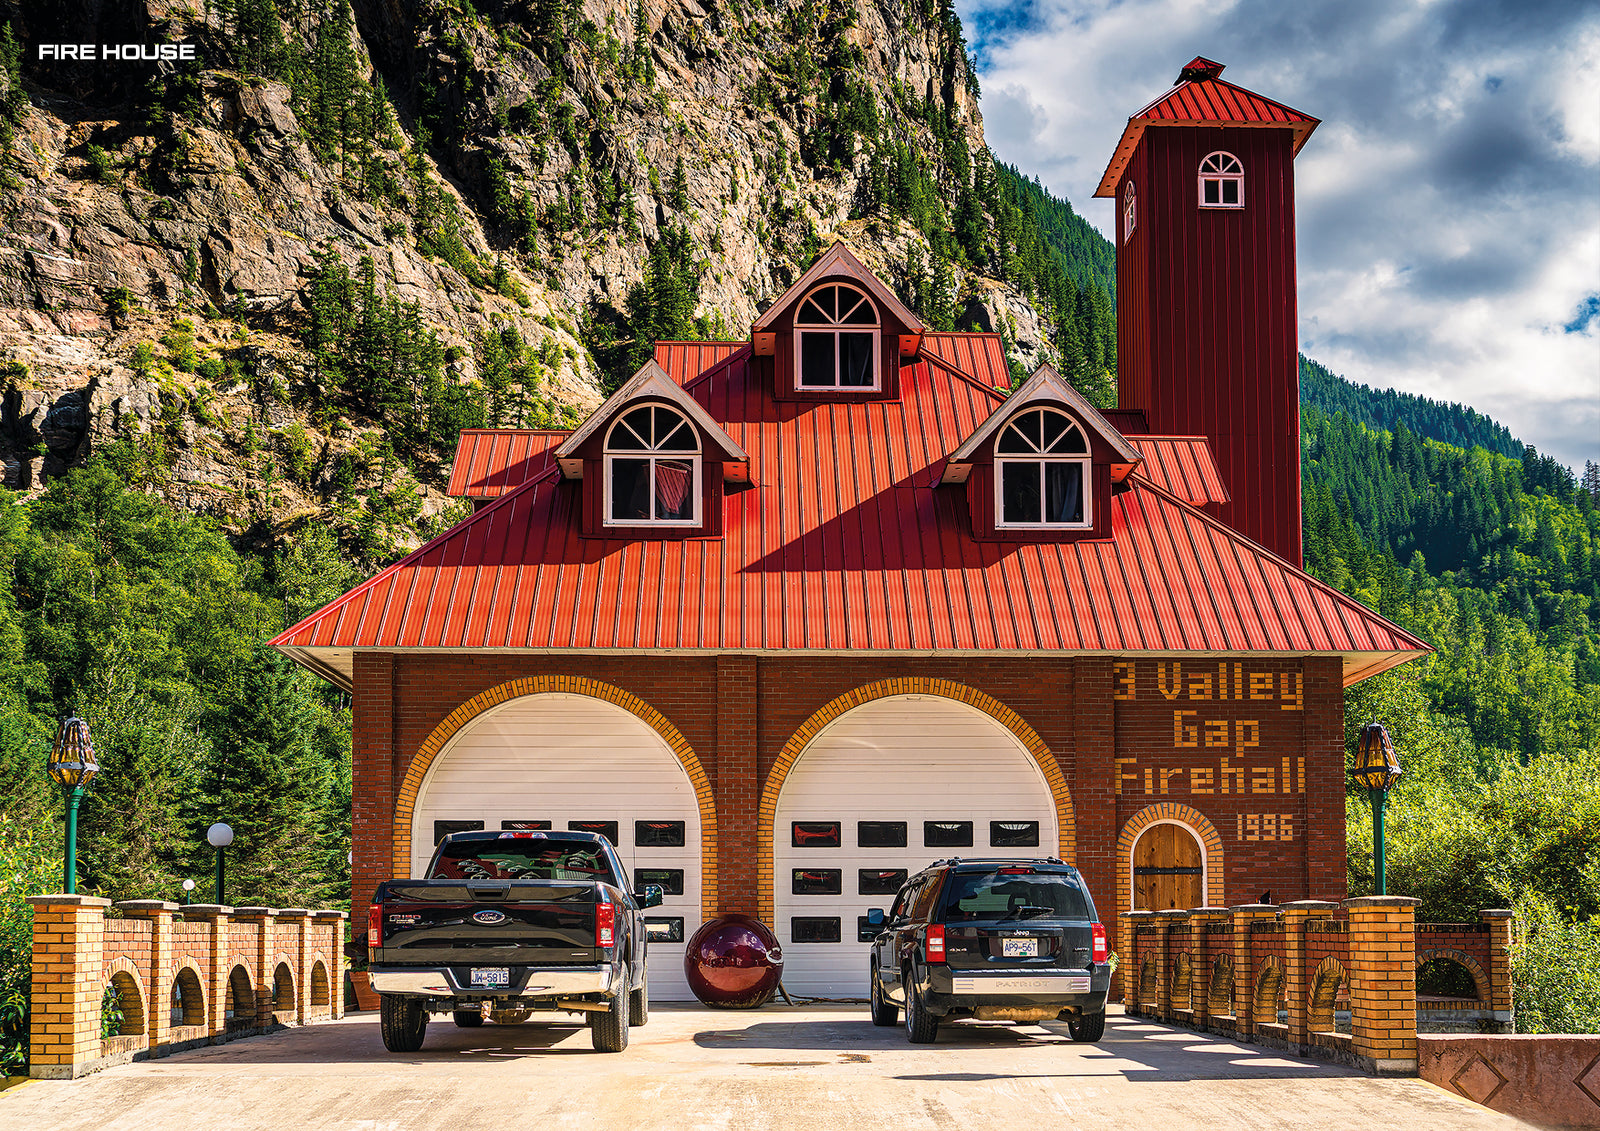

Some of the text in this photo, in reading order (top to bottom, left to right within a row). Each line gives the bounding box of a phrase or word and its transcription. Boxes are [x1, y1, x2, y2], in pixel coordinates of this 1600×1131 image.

[1113, 662, 1304, 711] 3 Valley
[1174, 710, 1260, 758] Gap
[1114, 757, 1306, 795] Firehall
[1237, 813, 1293, 841] 1996
[1013, 929, 1030, 937] Jeep
[995, 980, 1050, 988] PATRIOT
